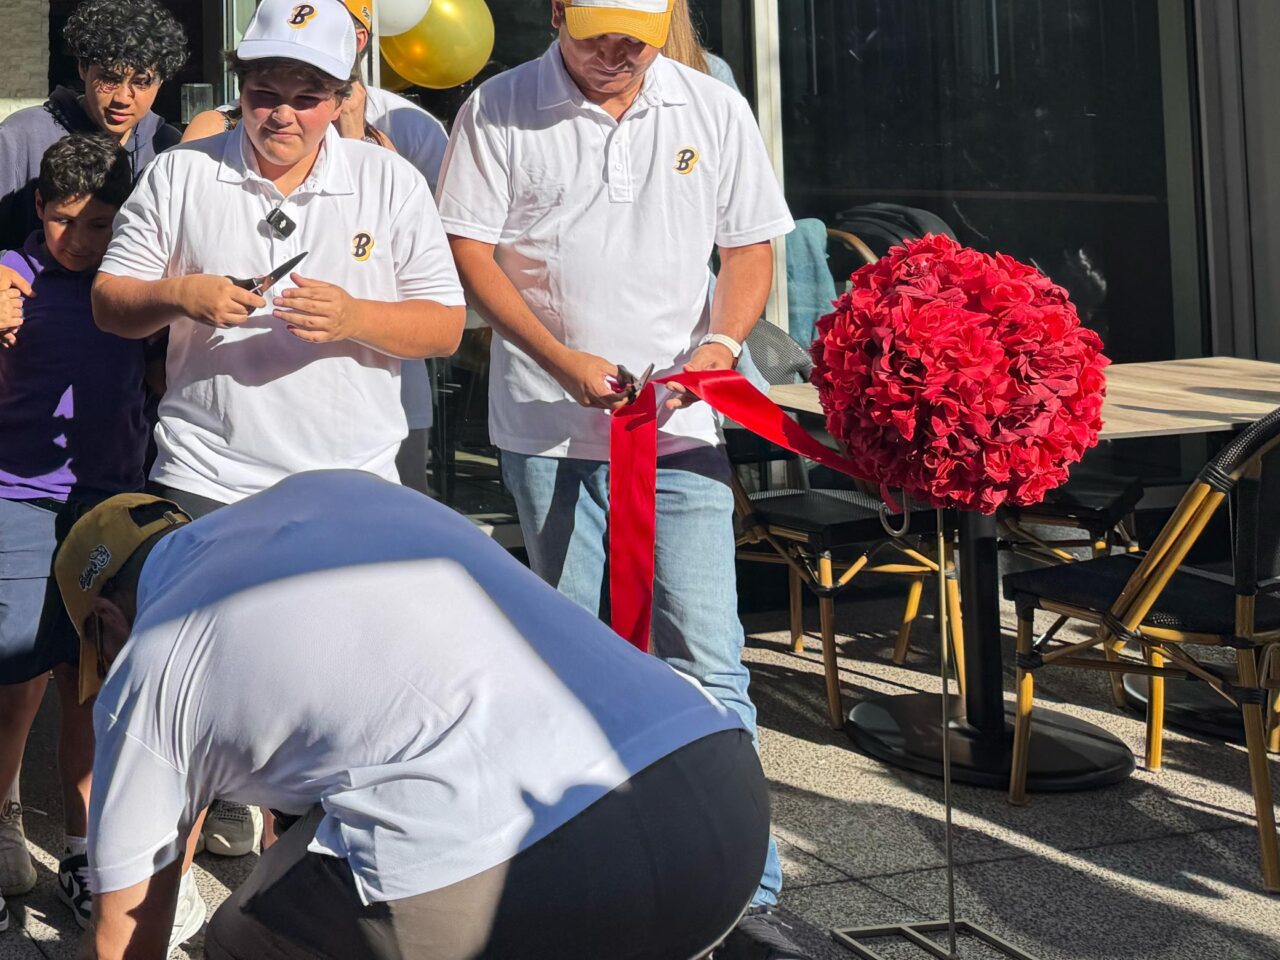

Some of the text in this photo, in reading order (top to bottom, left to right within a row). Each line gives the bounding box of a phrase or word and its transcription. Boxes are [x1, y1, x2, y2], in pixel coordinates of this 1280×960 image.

[288, 4, 316, 27] B
[676, 147, 698, 173] B
[352, 231, 373, 259] B
